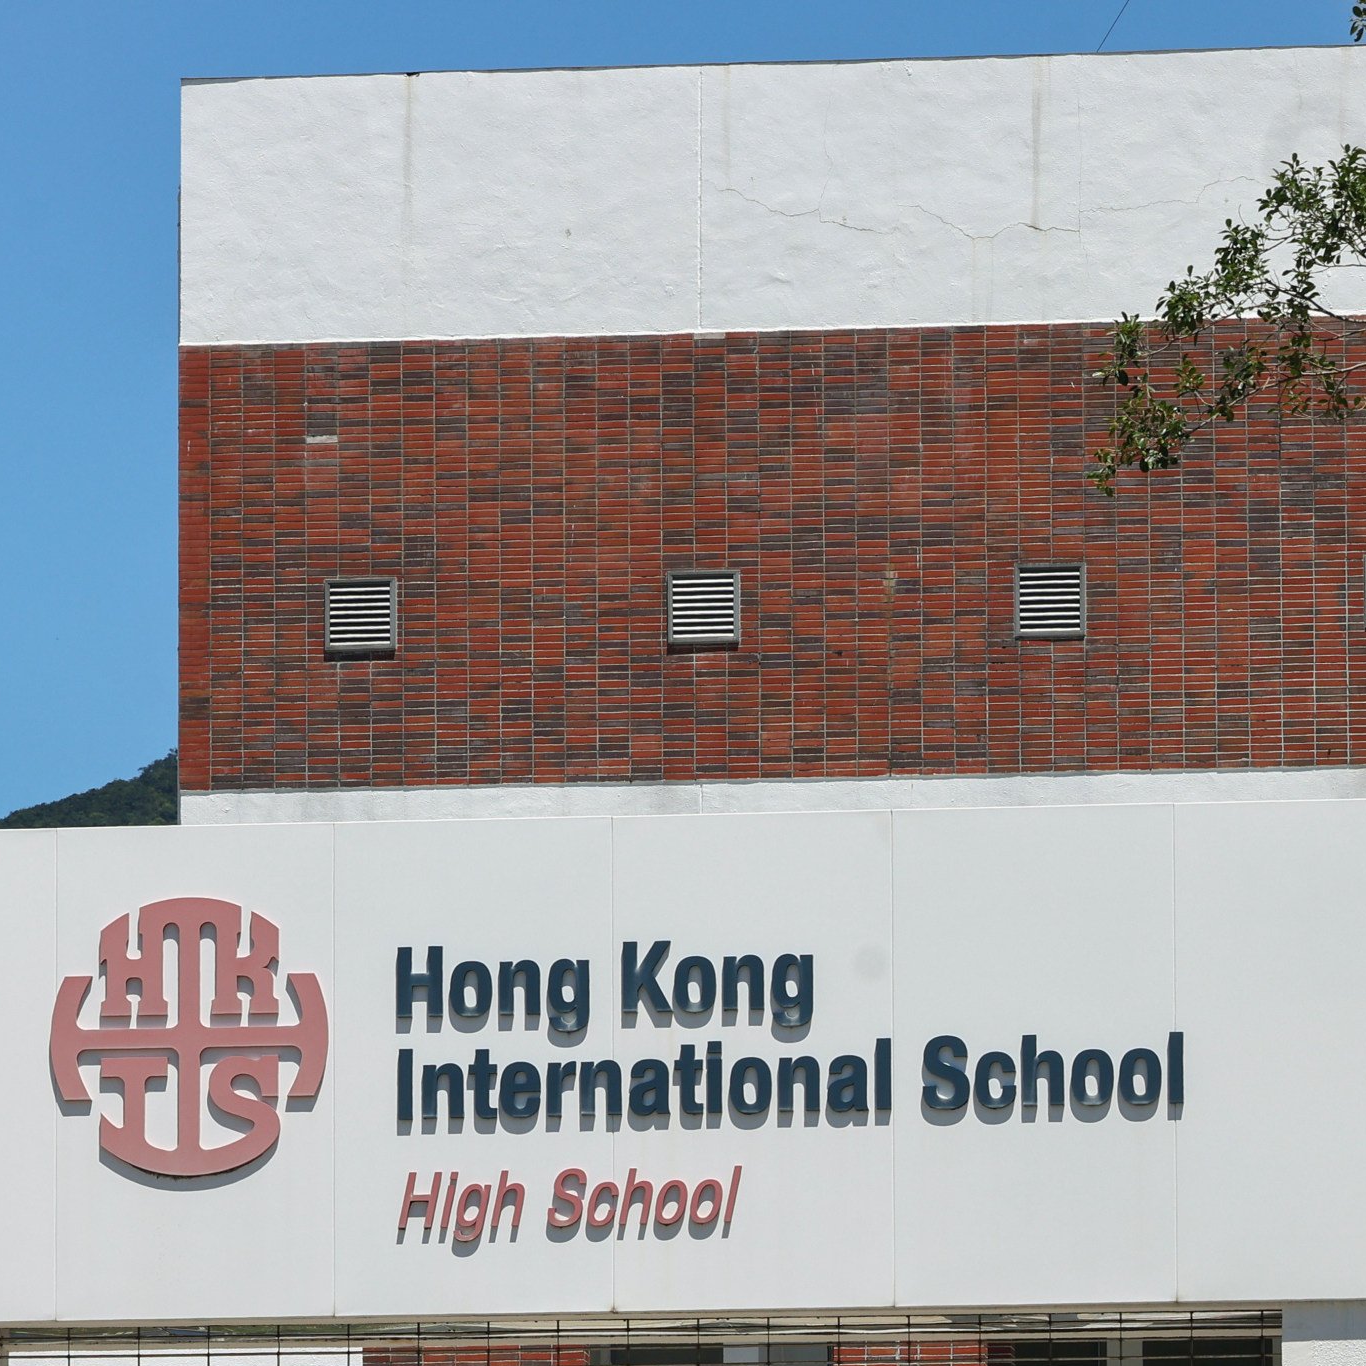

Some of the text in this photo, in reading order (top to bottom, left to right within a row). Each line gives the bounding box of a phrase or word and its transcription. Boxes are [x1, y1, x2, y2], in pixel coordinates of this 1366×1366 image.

[396, 940, 814, 1033] Hong Kong
[397, 1031, 1184, 1121] International School
[398, 1164, 743, 1242] High School
